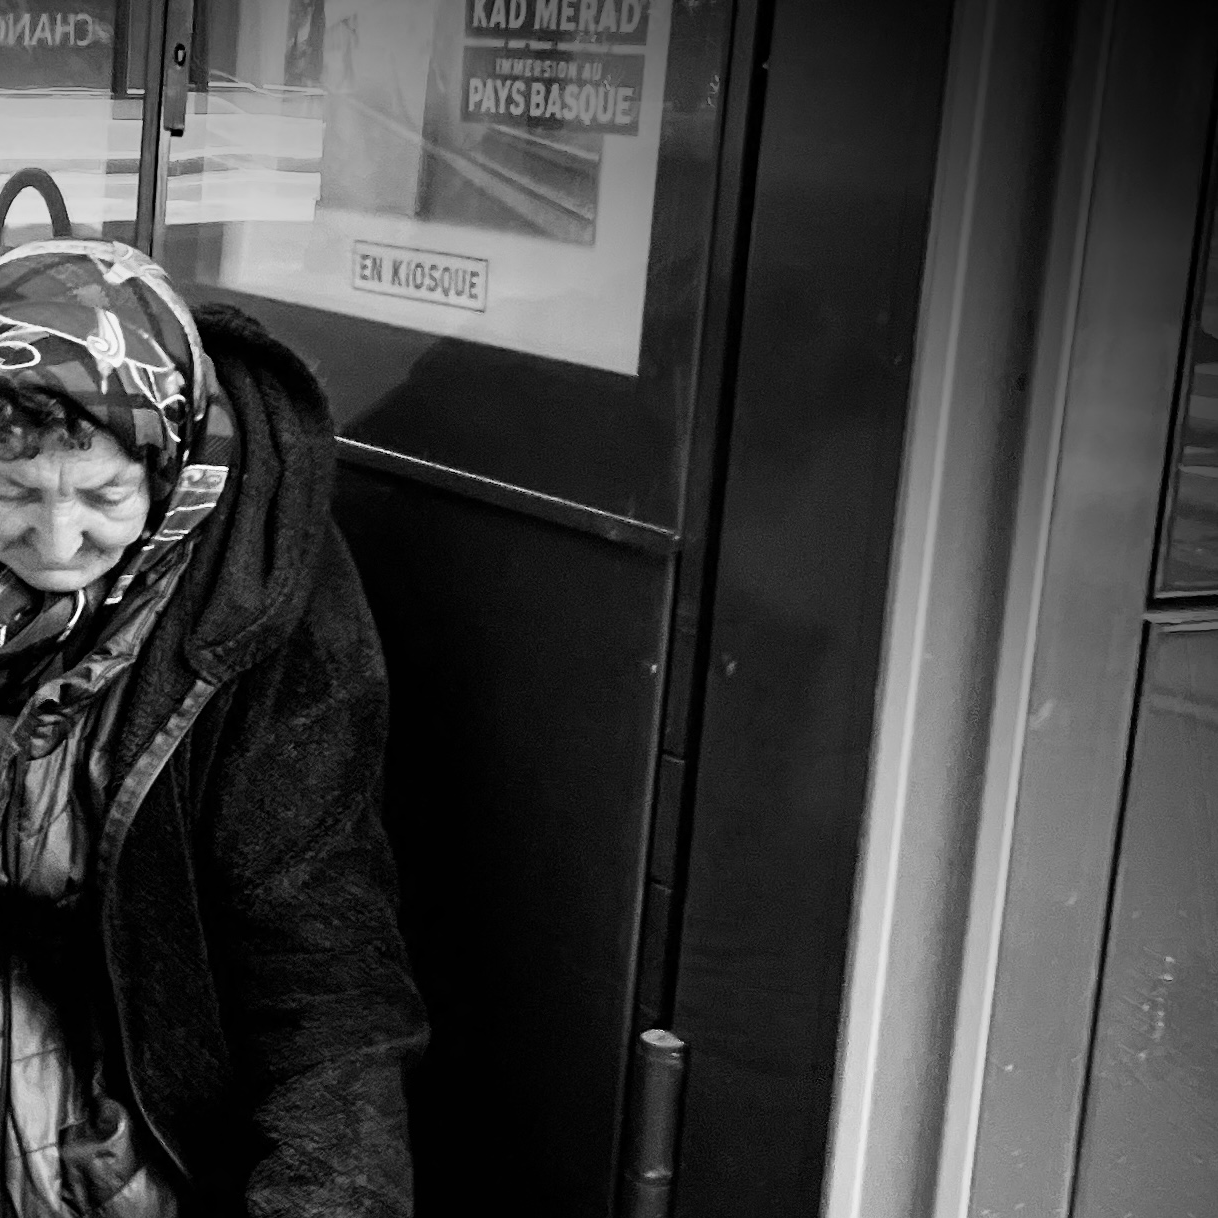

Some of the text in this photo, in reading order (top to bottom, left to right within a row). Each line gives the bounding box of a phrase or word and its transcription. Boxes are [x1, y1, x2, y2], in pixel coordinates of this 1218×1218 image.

[472, 0, 643, 33] KAD MERAD
[495, 58, 603, 81] IMMERSION AU
[468, 78, 635, 126] PAYS BASQUE
[360, 254, 480, 300] EN KIOSQUE
